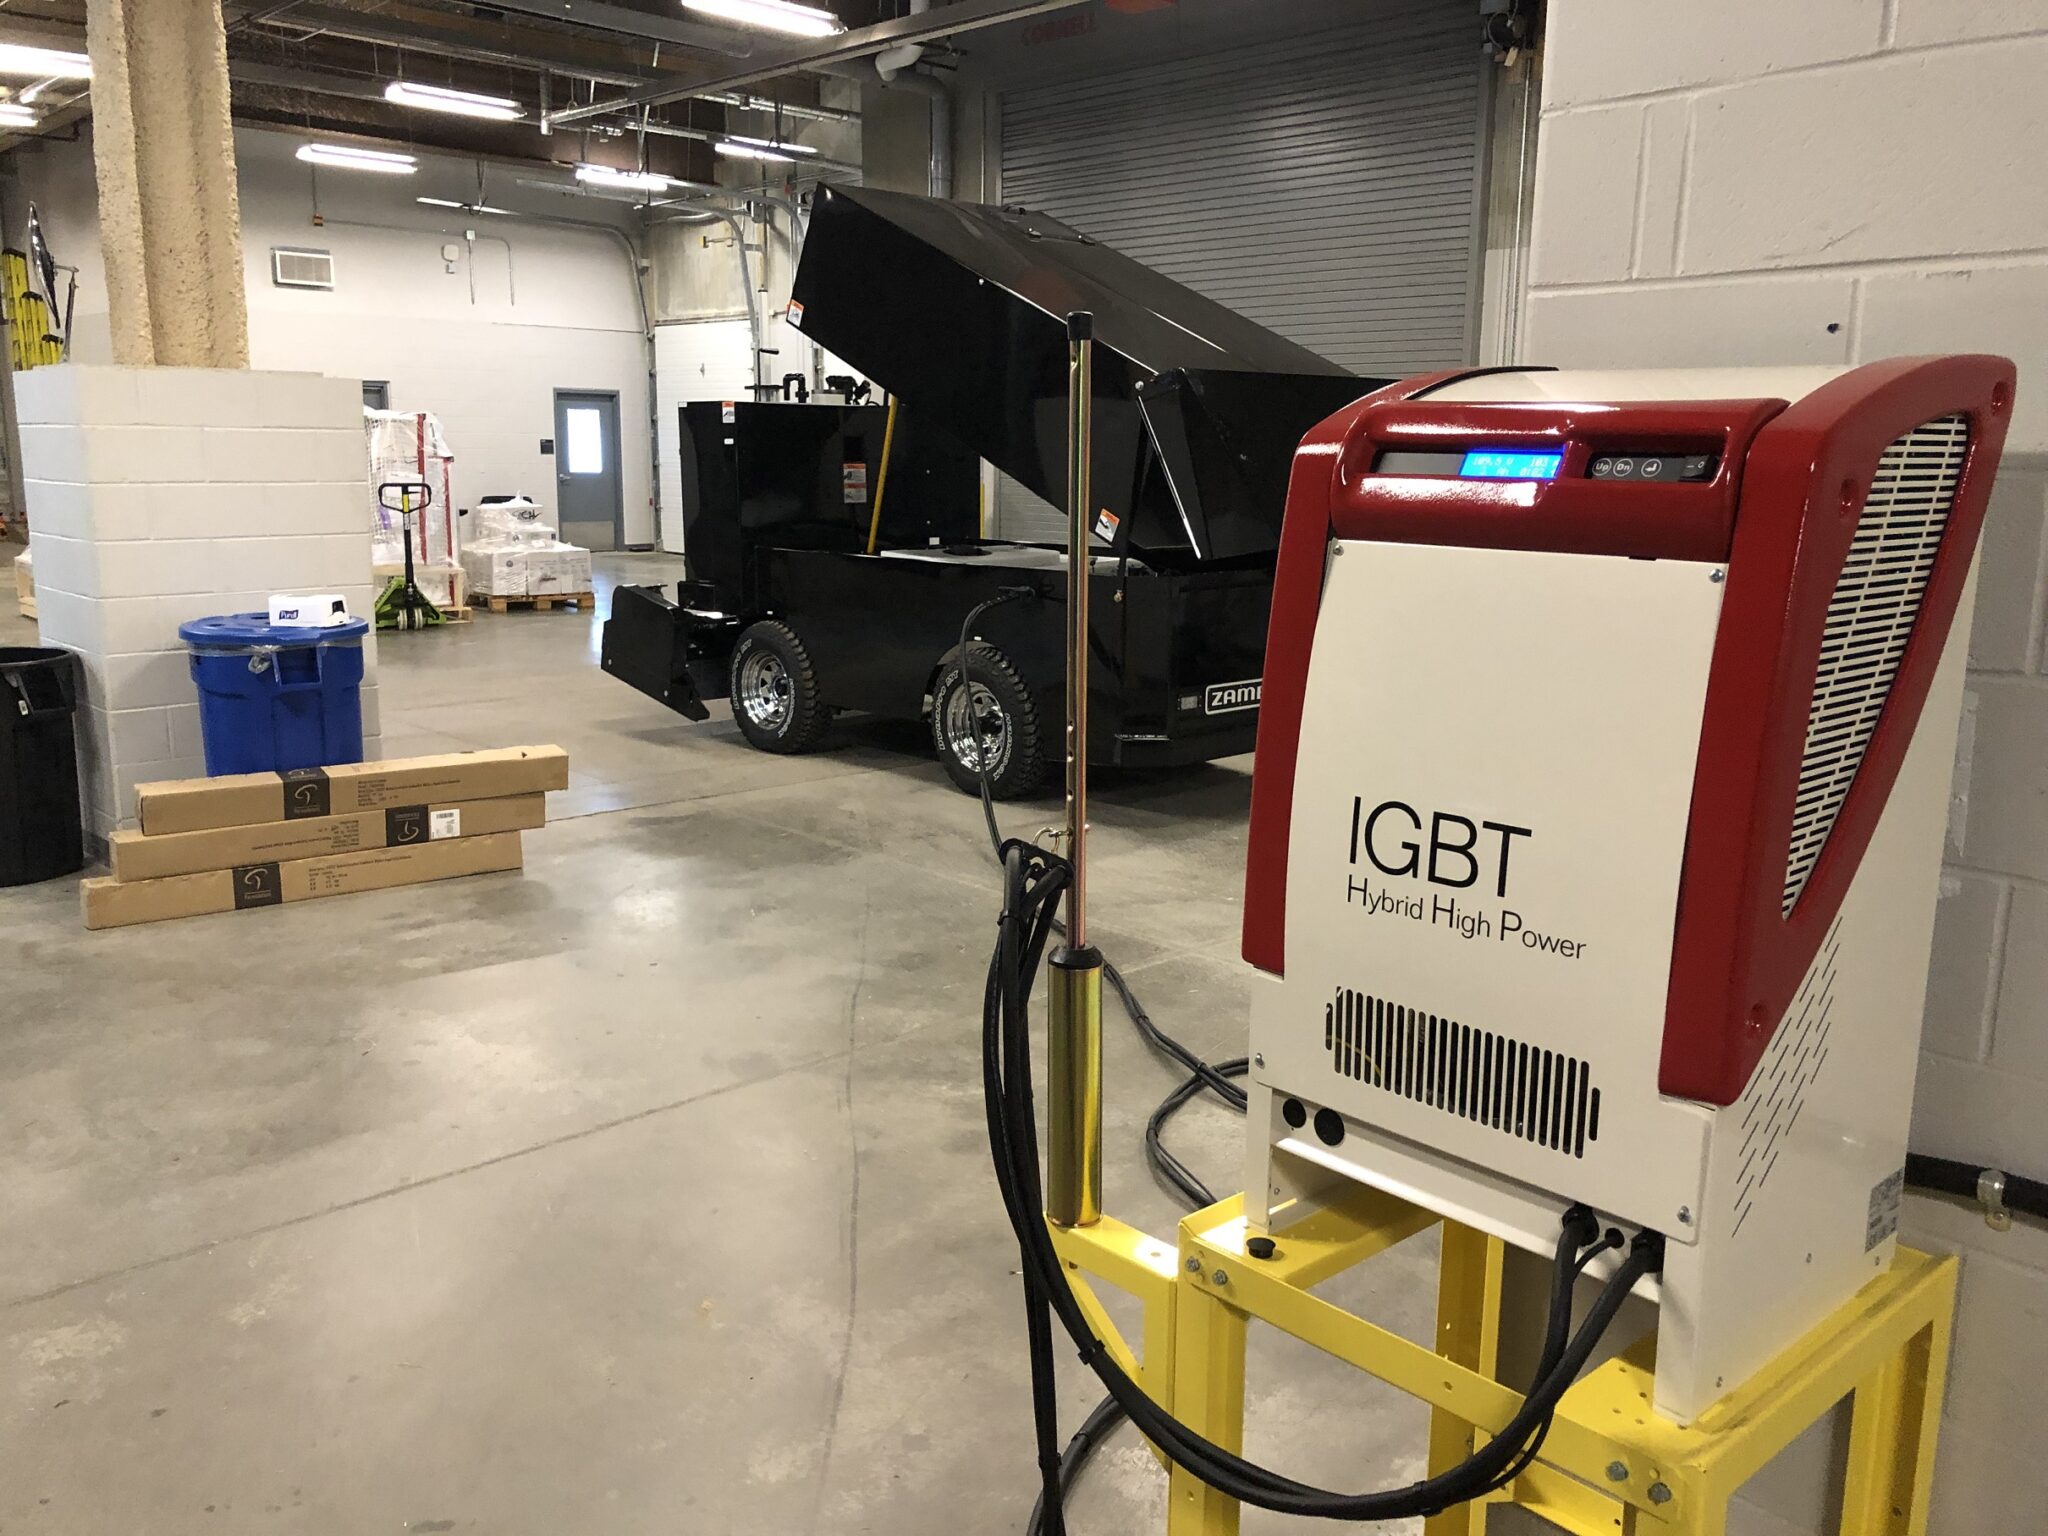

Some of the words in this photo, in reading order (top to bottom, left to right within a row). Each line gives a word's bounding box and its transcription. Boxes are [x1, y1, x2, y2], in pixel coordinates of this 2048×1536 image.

[1594, 462, 1609, 471] Up
[1616, 463, 1631, 471] Dn
[1349, 796, 1533, 898] IGBT
[1347, 874, 1424, 921] Hybrid
[1432, 894, 1491, 939] High
[1499, 910, 1587, 959] Power
